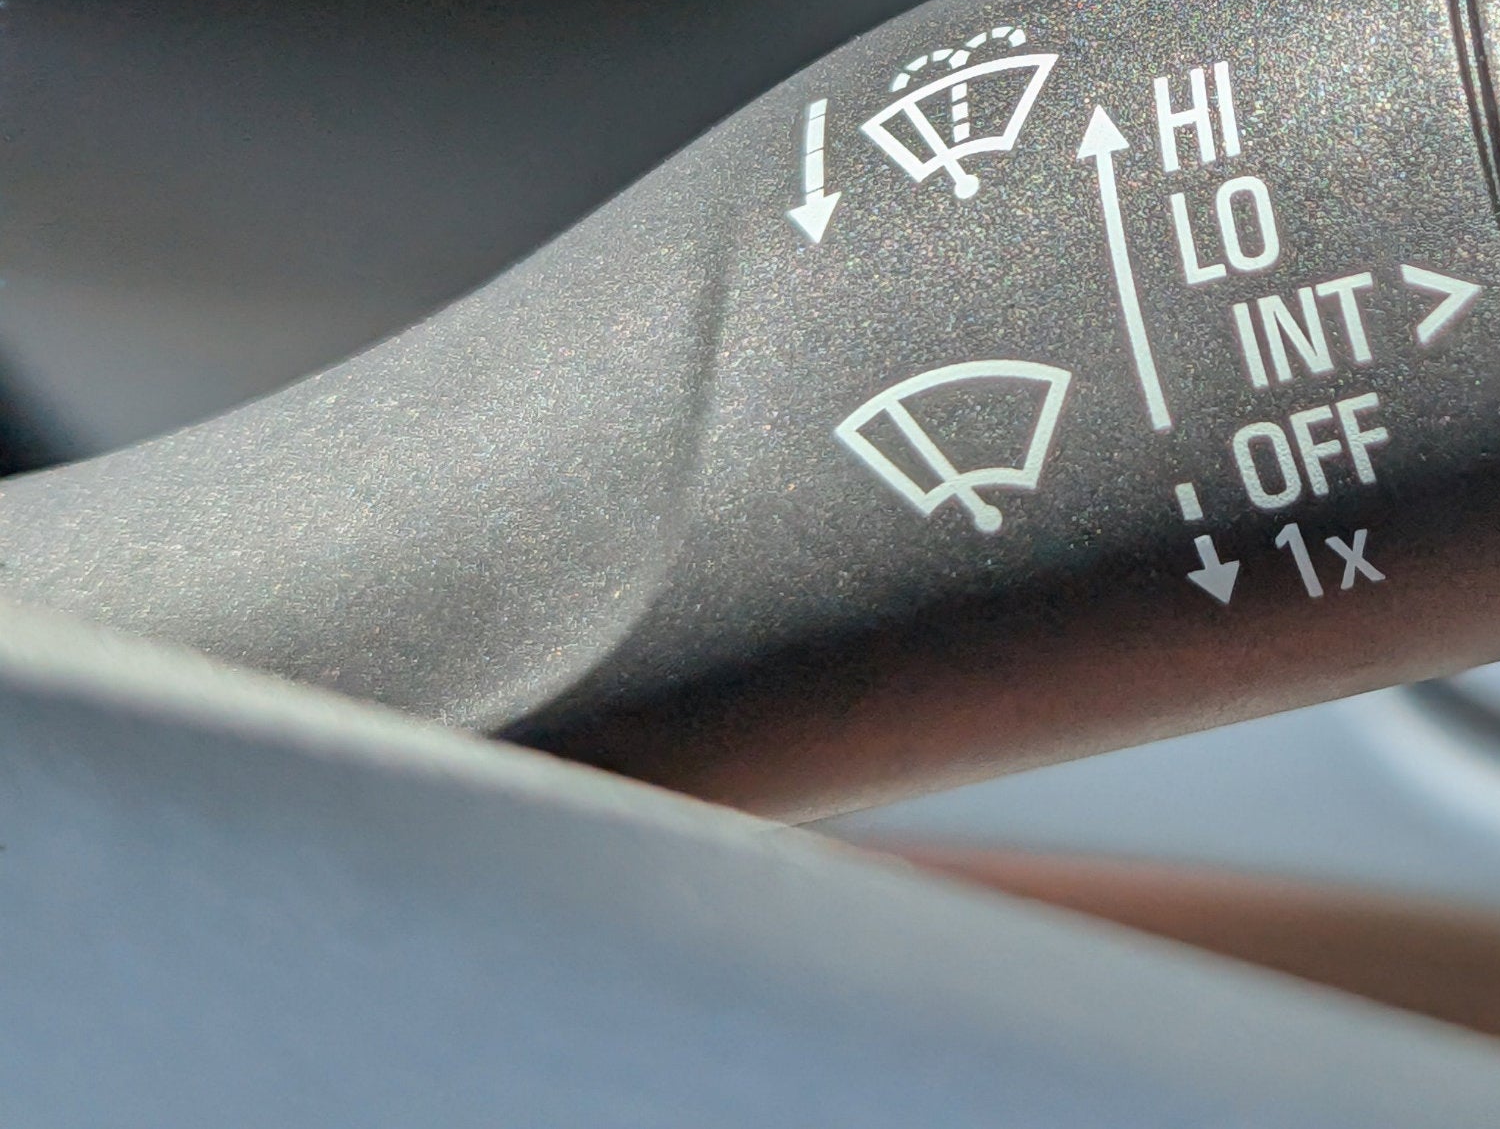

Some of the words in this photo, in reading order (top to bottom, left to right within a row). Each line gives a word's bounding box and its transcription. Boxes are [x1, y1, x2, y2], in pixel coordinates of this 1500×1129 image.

[1153, 61, 1240, 171] HI
[1170, 175, 1281, 285] LO
[1233, 272, 1373, 388] INT
[1232, 392, 1390, 510] OFF
[1275, 523, 1386, 597] 1x
